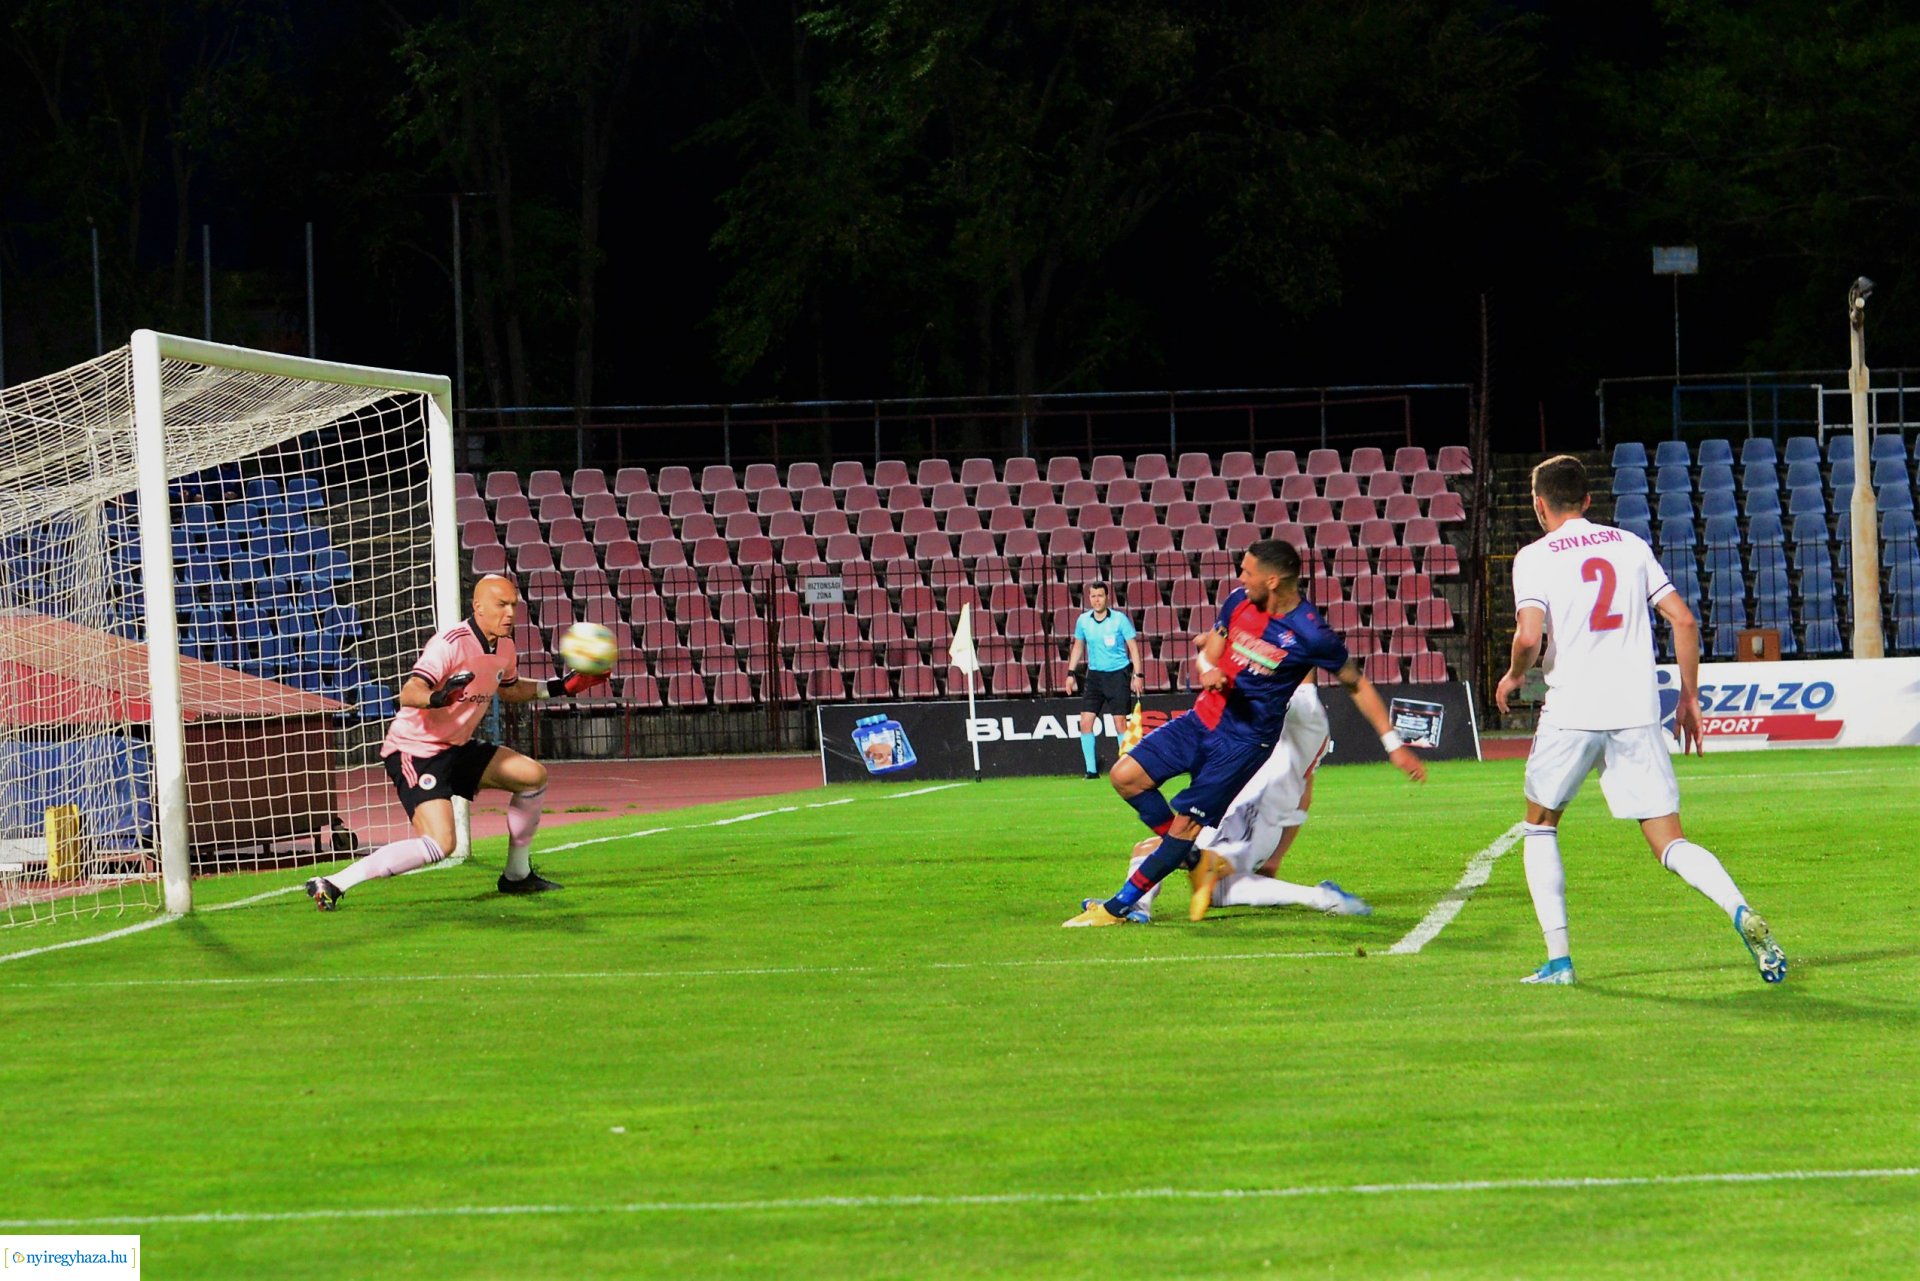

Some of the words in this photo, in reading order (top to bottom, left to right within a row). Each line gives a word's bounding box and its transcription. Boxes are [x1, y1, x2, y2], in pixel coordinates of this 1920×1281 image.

[1548, 530, 1623, 552] SZIVACSKI
[1581, 557, 1624, 632] 2
[1698, 681, 1835, 712] SZI-ZO
[1701, 718, 1764, 734] SPORT
